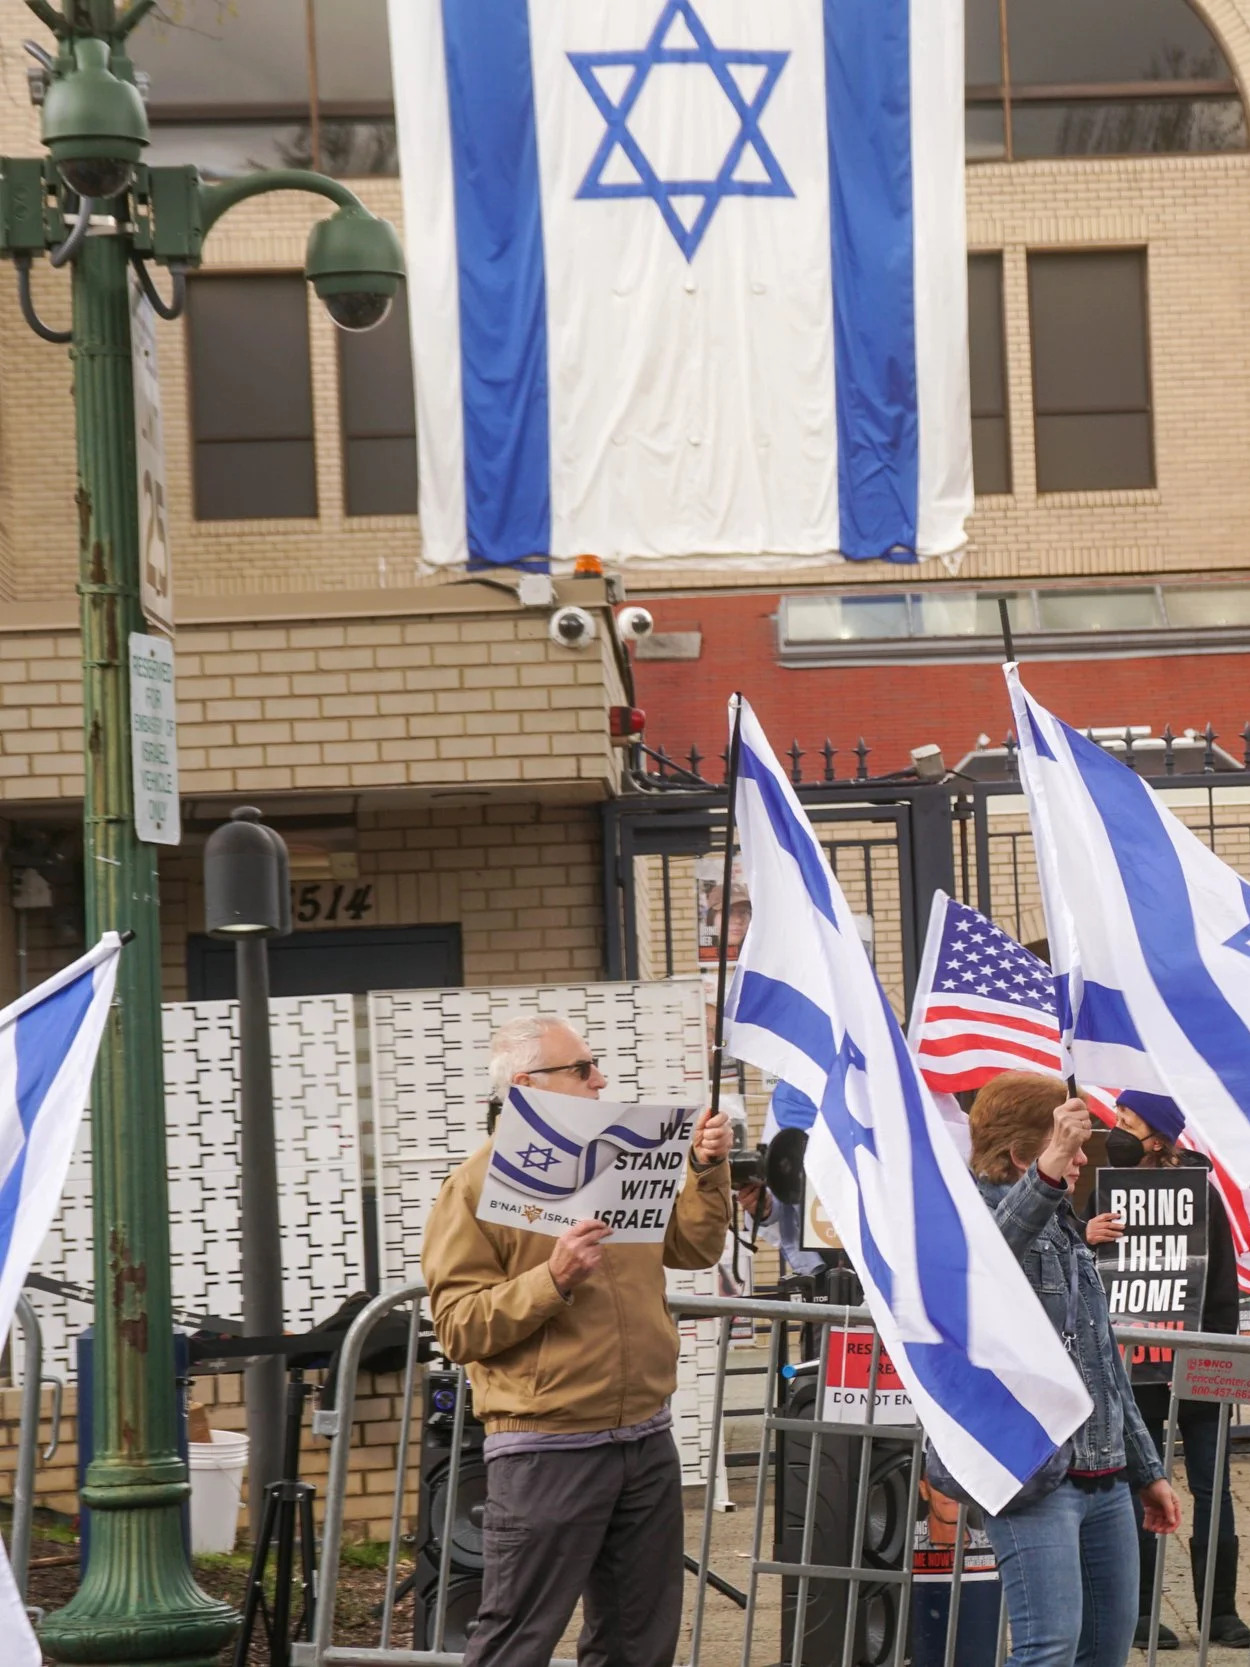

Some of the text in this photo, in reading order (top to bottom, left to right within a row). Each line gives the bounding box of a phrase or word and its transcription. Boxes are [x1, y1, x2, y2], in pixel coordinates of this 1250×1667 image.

[132, 655, 172, 684] RESERVED
[145, 688, 161, 709] FOR
[142, 741, 169, 765] ISRAEL
[148, 799, 169, 821] ONLY
[291, 883, 373, 922] 514
[660, 1122, 693, 1140] WE
[614, 1152, 683, 1170] STAND
[621, 1180, 676, 1200] WITH
[490, 1200, 581, 1227] B'NAI ISRAE
[594, 1209, 665, 1229] ISRAEL
[1111, 1188, 1194, 1227] BRING
[1115, 1235, 1188, 1272] THEM
[1109, 1279, 1188, 1313] HOME
[833, 1392, 855, 1404] DO
